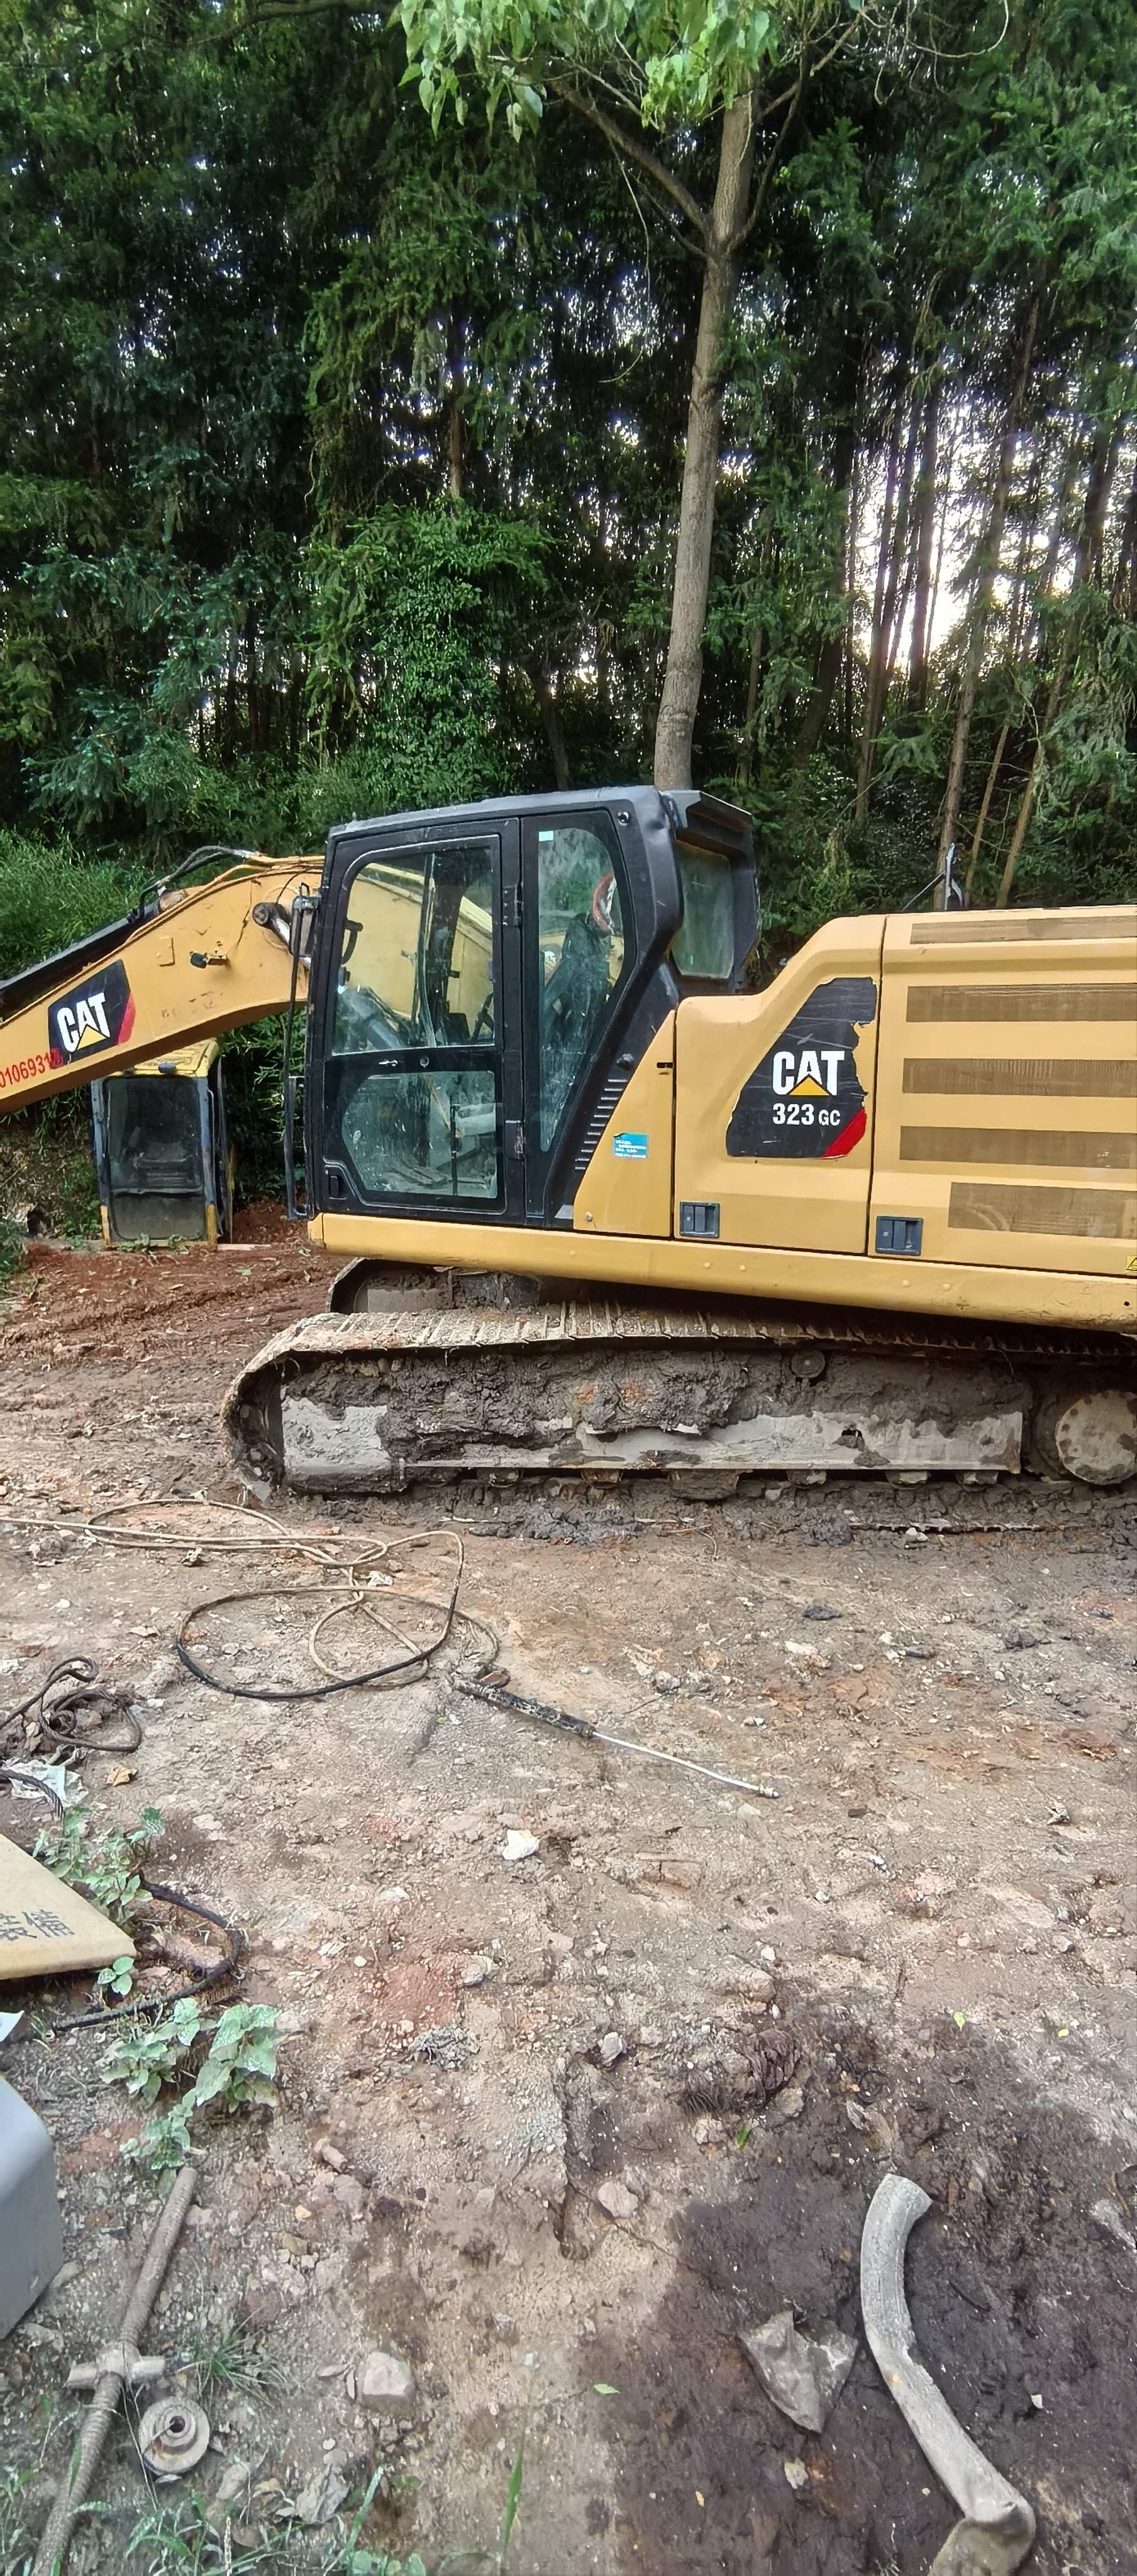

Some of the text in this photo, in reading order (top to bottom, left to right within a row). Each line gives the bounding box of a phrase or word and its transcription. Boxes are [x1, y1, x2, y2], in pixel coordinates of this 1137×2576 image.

[57, 992, 110, 1052] CAT
[772, 1050, 845, 1096] CAT
[772, 1102, 841, 1126] 323 GC
